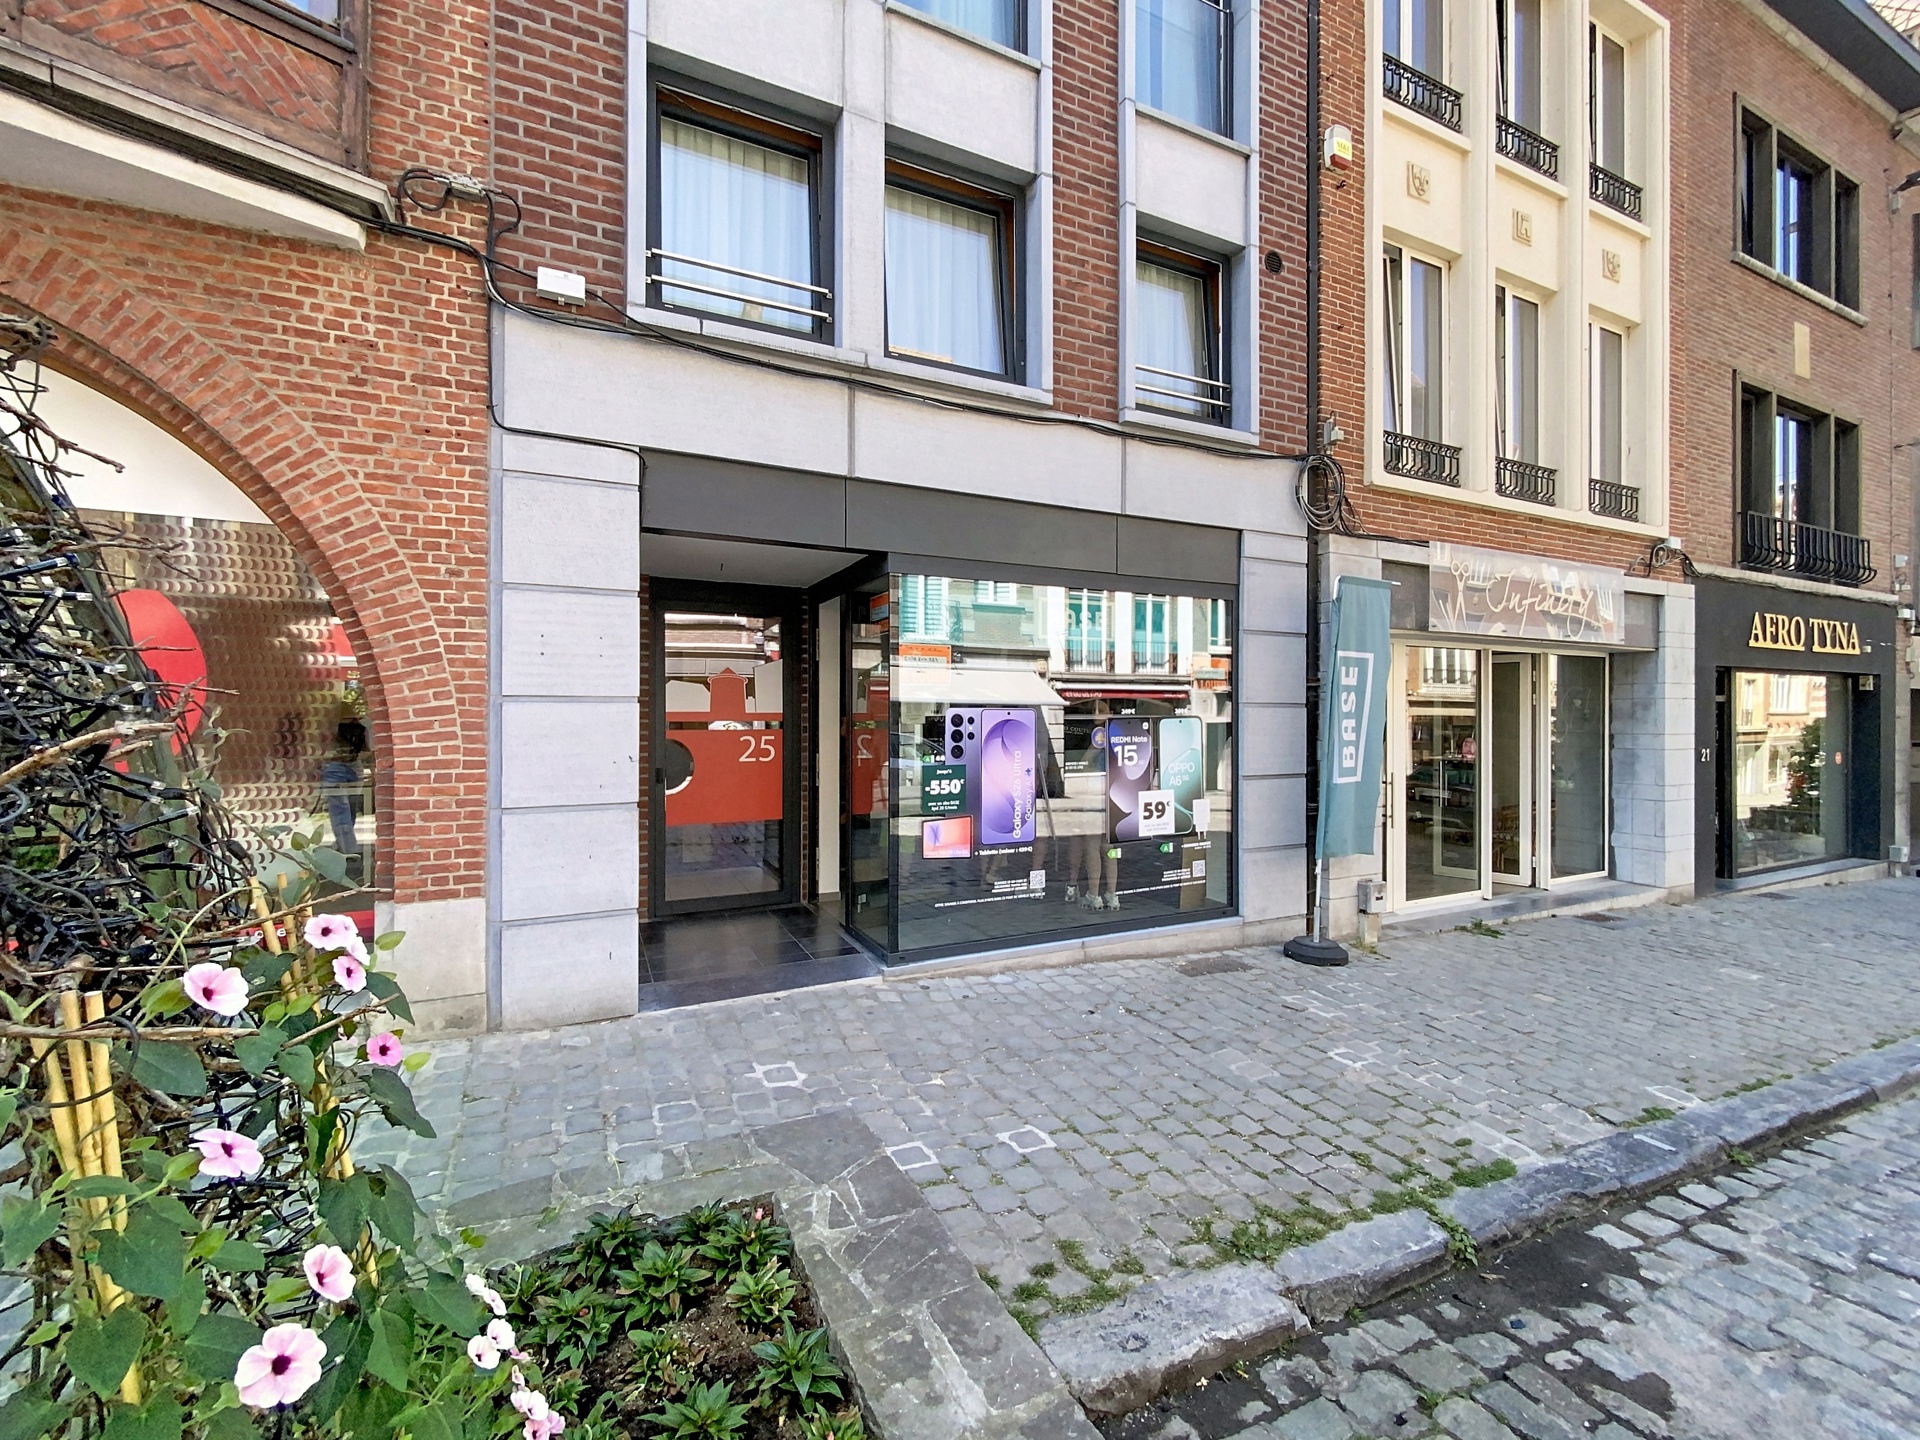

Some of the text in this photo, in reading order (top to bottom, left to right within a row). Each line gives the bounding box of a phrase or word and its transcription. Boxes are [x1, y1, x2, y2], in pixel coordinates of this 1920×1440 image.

[1749, 612, 1861, 655] AFRO TYNA
[1341, 666, 1359, 768] BASE
[738, 735, 776, 762] 25
[1111, 735, 1148, 744] REDMI Note
[1014, 750, 1022, 776] Ultra
[1113, 745, 1138, 767] 15
[1168, 762, 1195, 774] OPPO
[1701, 749, 1710, 761] 21
[1169, 775, 1182, 786] A6
[1025, 788, 1034, 821] Galaxy
[1013, 800, 1023, 839] Galaxy
